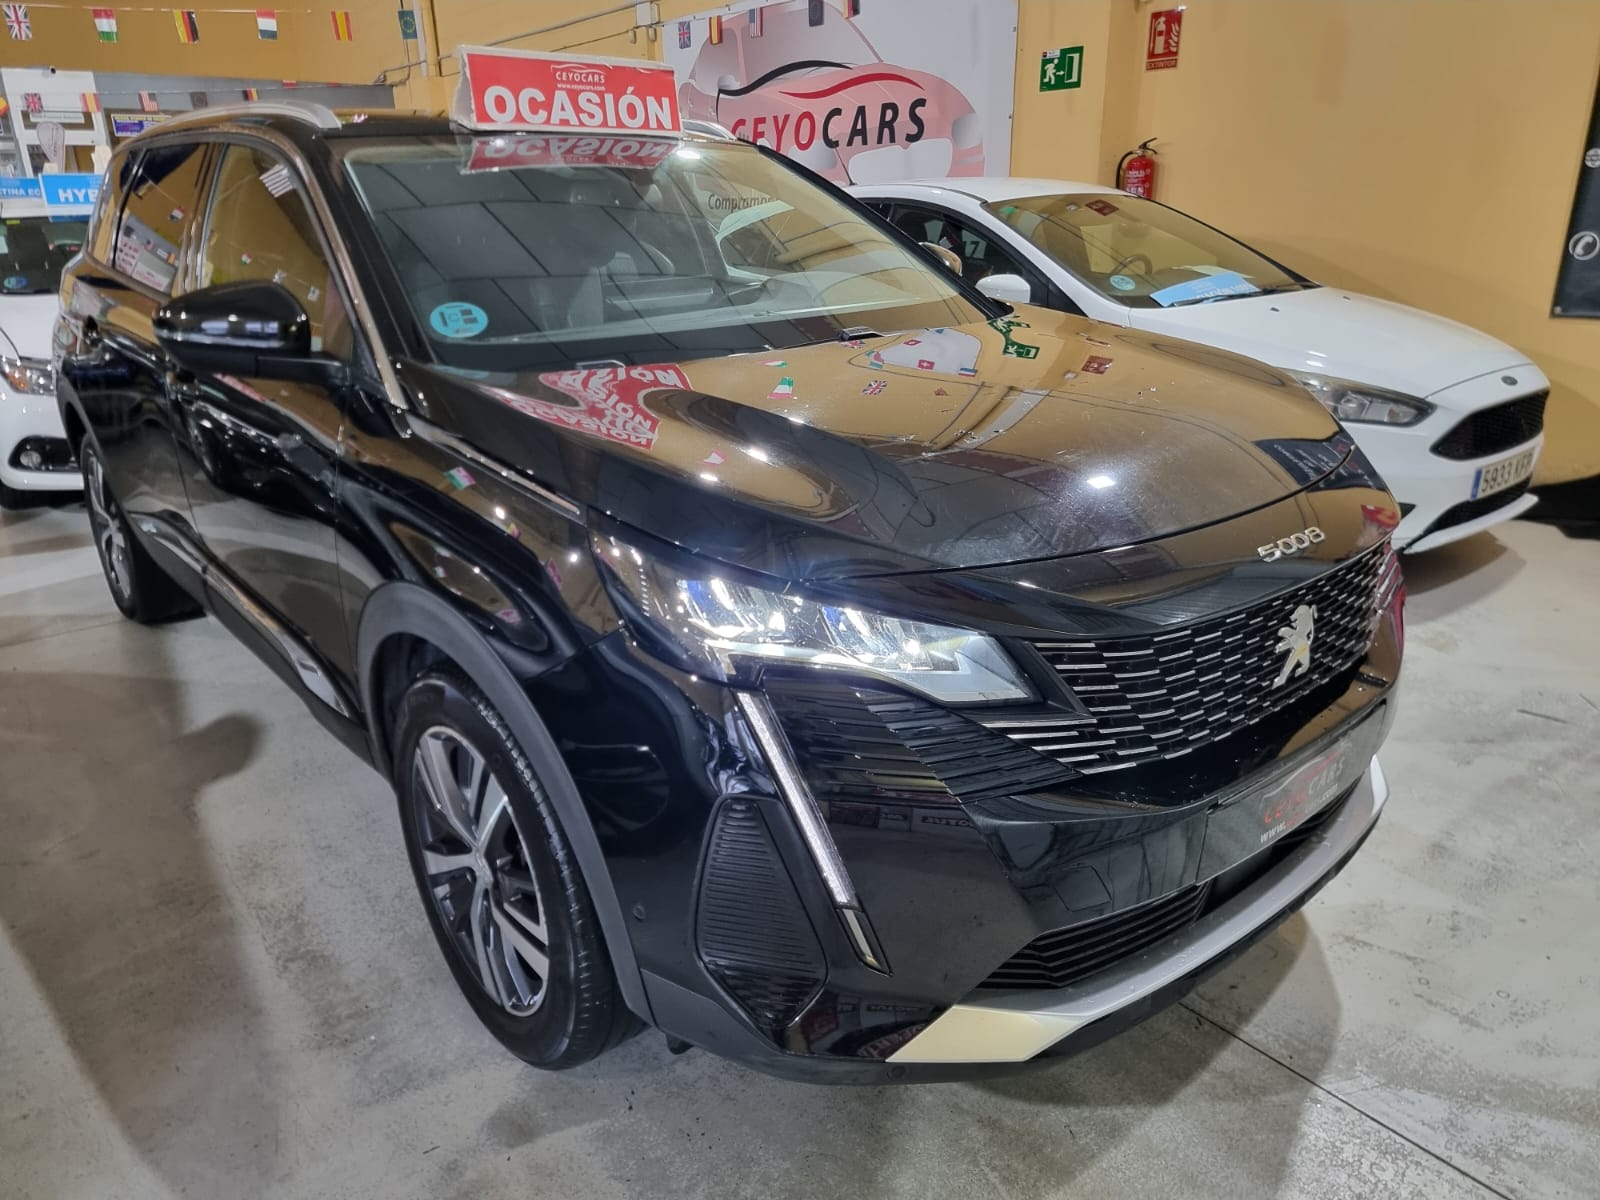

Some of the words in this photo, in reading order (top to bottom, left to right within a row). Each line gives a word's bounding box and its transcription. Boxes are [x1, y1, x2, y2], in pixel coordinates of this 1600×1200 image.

[555, 71, 605, 84] CEYOCARS
[483, 85, 673, 130] OCASIÓN
[1257, 526, 1325, 562] 5008
